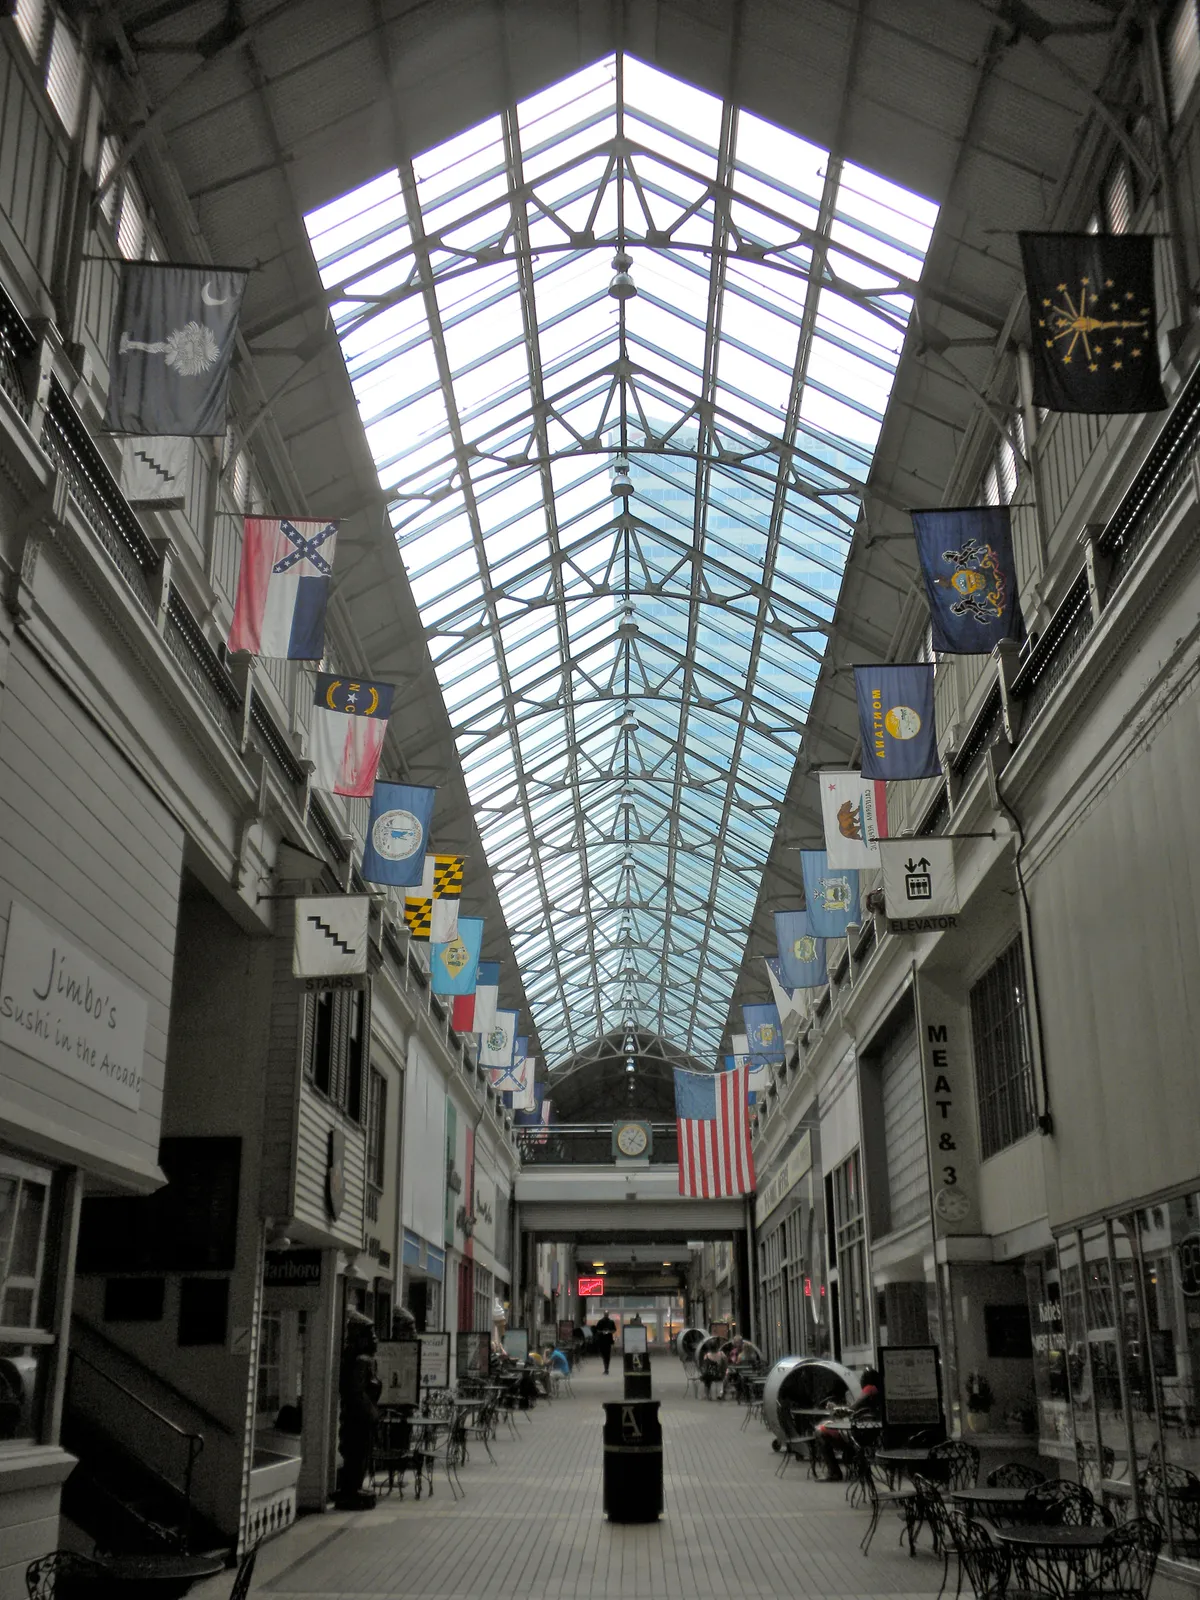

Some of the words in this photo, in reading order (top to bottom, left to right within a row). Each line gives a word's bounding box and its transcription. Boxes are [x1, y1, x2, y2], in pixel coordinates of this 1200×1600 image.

[345, 704, 356, 713] C
[891, 916, 957, 932] ELEVATOR
[32, 947, 117, 1030] Jimbo's
[305, 975, 354, 991] STAIRS
[0, 994, 50, 1040] Sushi
[54, 1018, 73, 1052] in
[76, 1038, 97, 1069] the
[99, 1052, 142, 1094] Arcade
[927, 1024, 952, 1119] MEAT
[938, 1131, 957, 1152] &
[942, 1165, 958, 1186] 3
[621, 1405, 643, 1437] A
